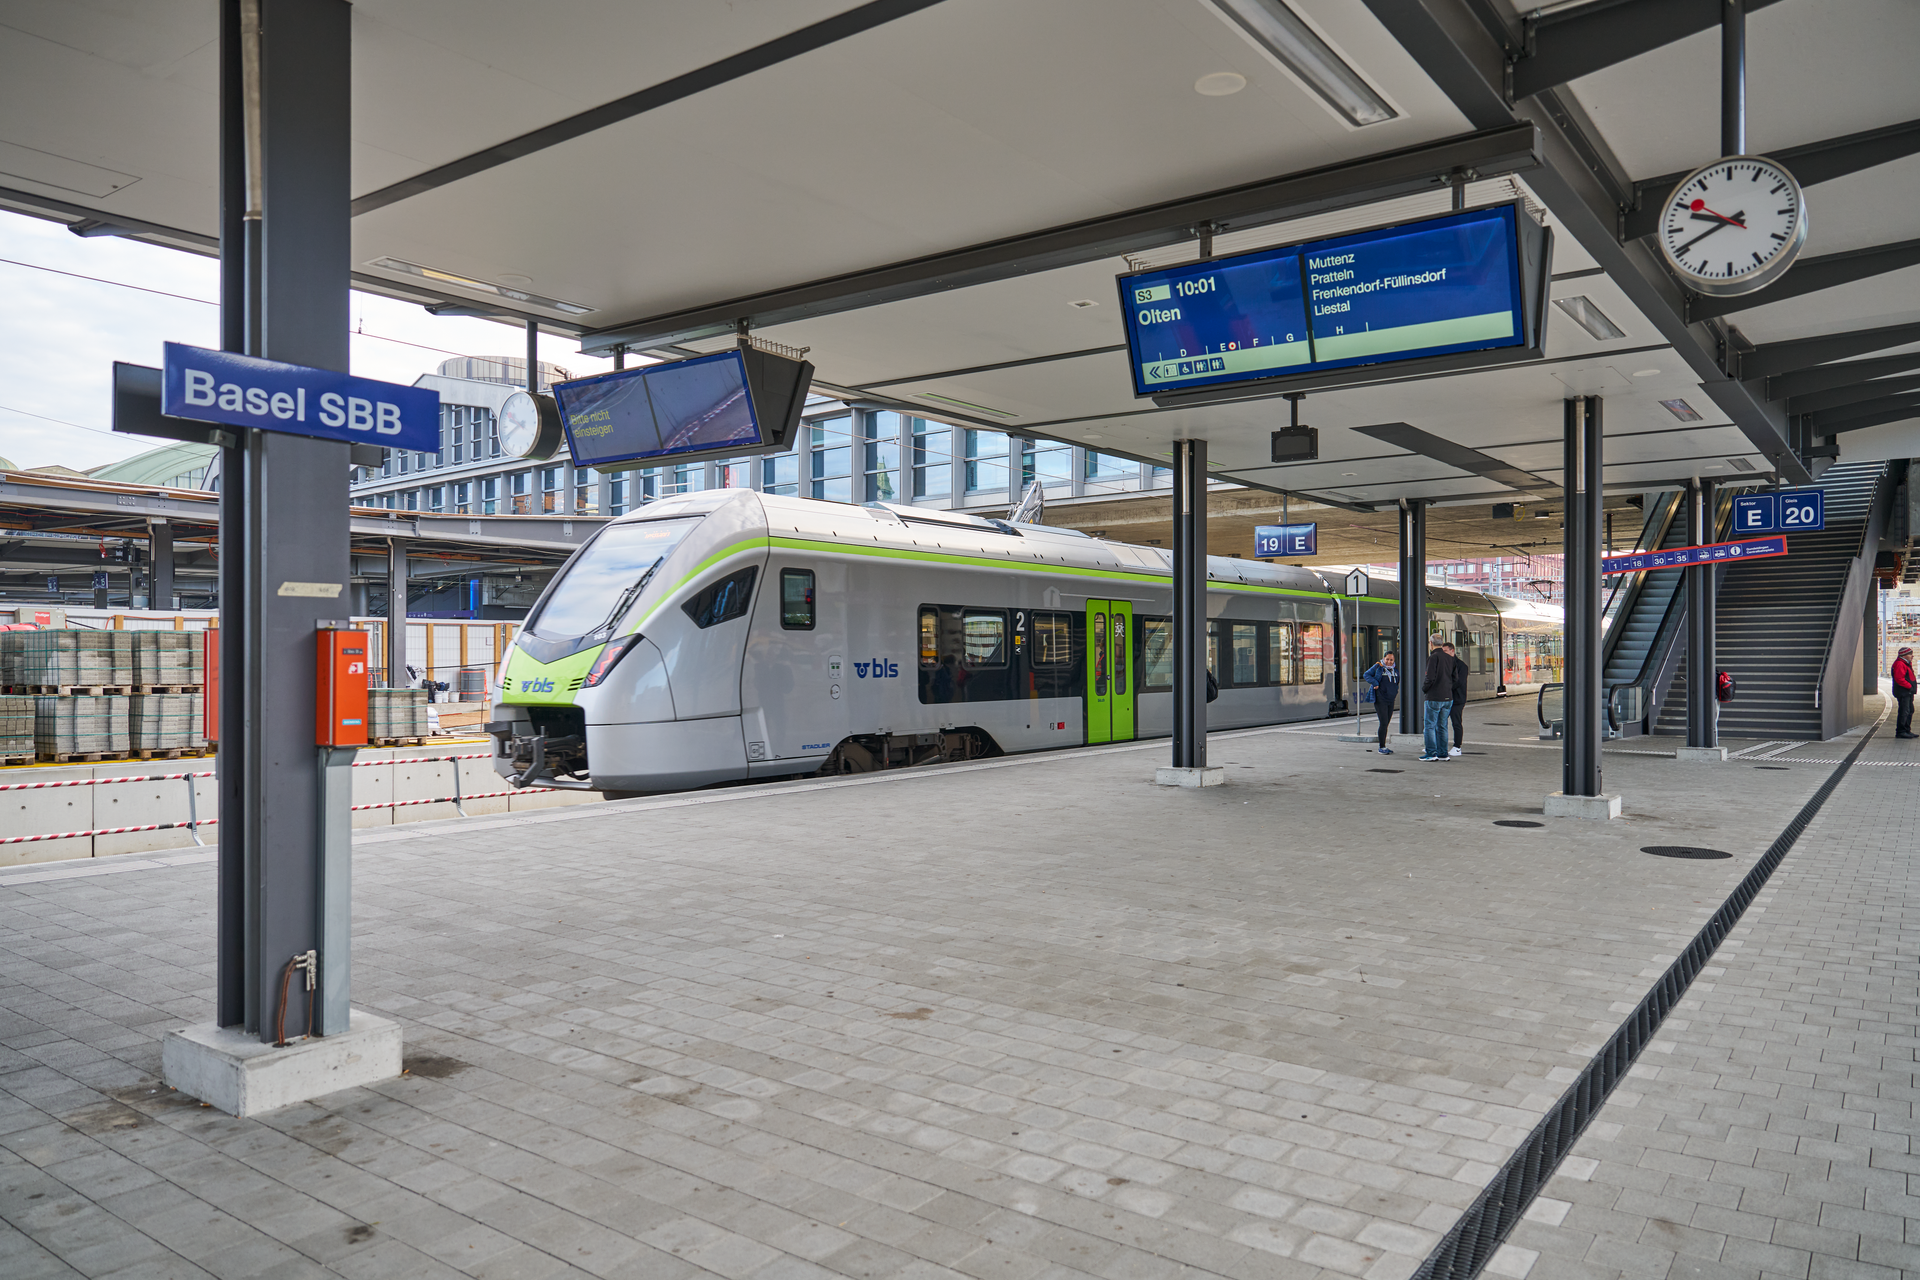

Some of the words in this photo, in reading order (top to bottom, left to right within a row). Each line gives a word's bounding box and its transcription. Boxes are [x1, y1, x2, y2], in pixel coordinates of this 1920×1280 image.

[1309, 253, 1355, 270] Muttenz
[1311, 269, 1354, 285] Pratteln
[1312, 268, 1447, 300] Frenkendorf-Füllinsdorf
[1137, 289, 1153, 302] S3
[1176, 276, 1216, 297] 10:01
[1138, 307, 1181, 326] Olten
[1314, 300, 1351, 316] Liestal
[1180, 349, 1187, 357] D
[1219, 343, 1226, 351] E
[1252, 338, 1259, 347] F
[1286, 333, 1294, 342] G
[1335, 325, 1344, 335] H
[184, 368, 306, 422] Basel
[318, 392, 402, 436] SBB
[570, 414, 590, 425] Bitte
[590, 409, 611, 422] nicht
[574, 424, 614, 438] einsteigen
[1747, 509, 1762, 526] E
[1785, 506, 1815, 524] 20
[1261, 537, 1279, 551] 19
[1295, 536, 1306, 550] E
[1654, 557, 1665, 565] 30
[1676, 554, 1687, 562] 35
[1353, 575, 1359, 593] 1
[1015, 611, 1025, 632] 2
[872, 658, 899, 678] bls
[532, 677, 555, 692] bls
